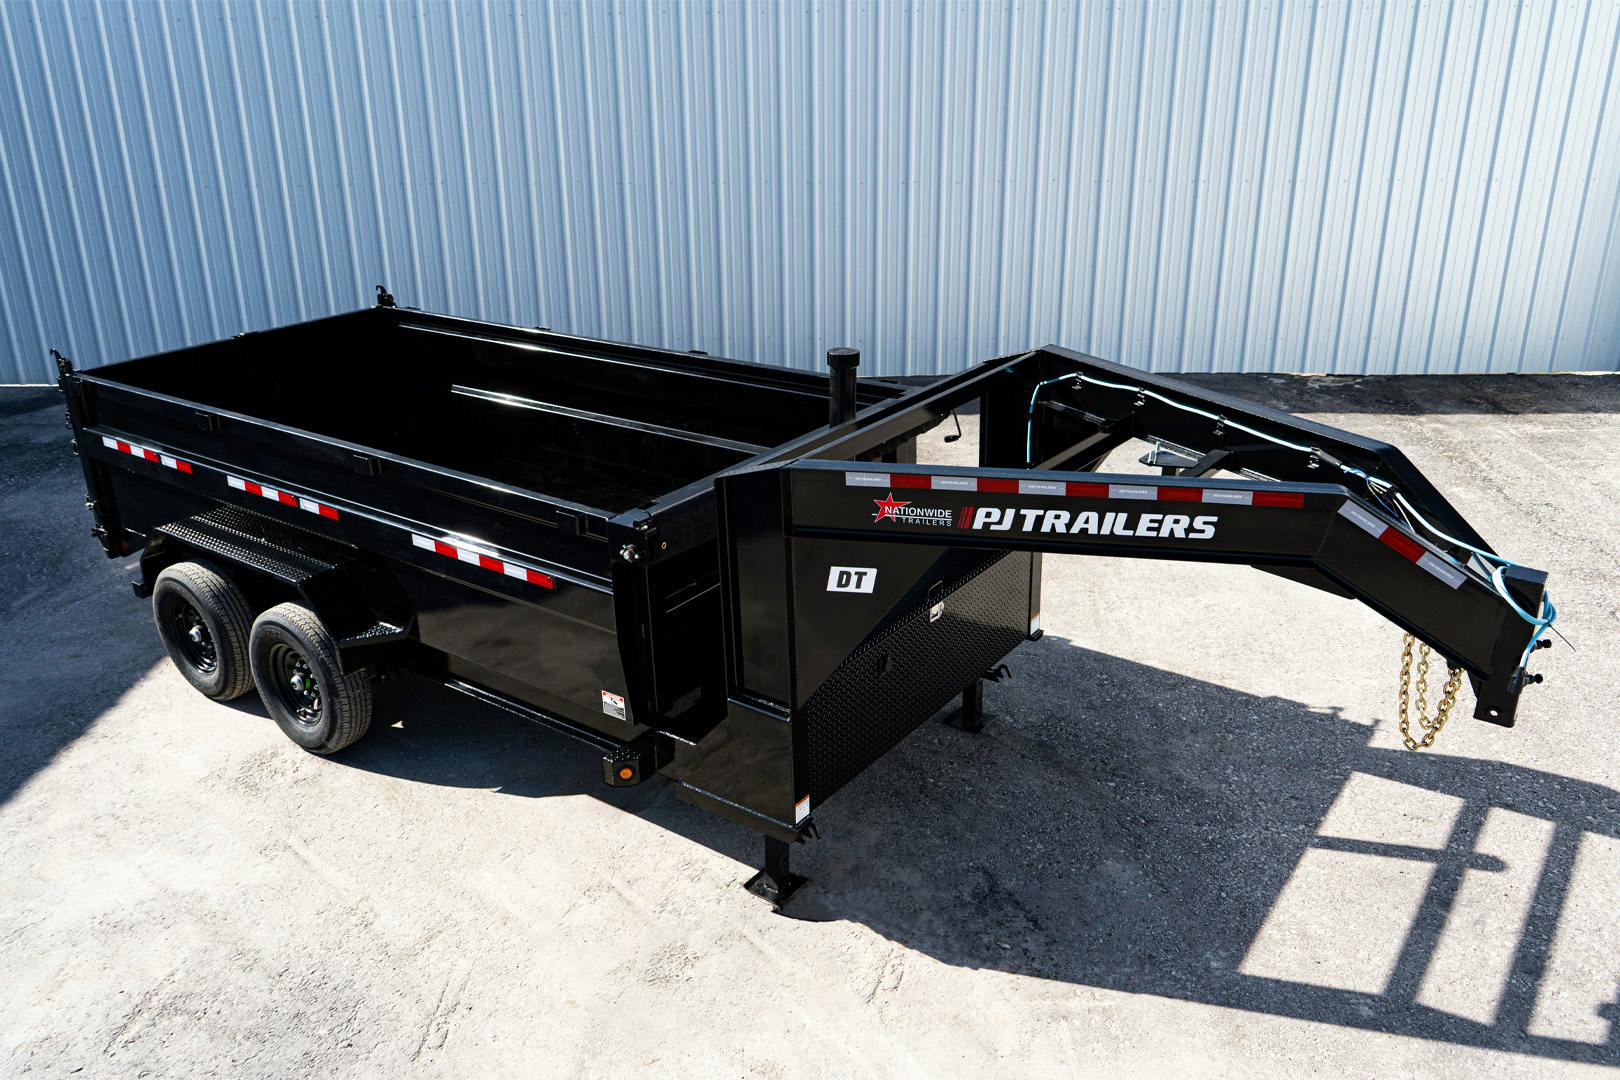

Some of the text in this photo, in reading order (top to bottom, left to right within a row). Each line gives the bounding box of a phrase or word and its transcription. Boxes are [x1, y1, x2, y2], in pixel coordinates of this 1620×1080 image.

[884, 505, 953, 519] NATIONWIDE
[902, 517, 952, 527] TRAILERS
[972, 507, 1219, 540] PJ TRAILERS
[836, 570, 868, 590] DT
